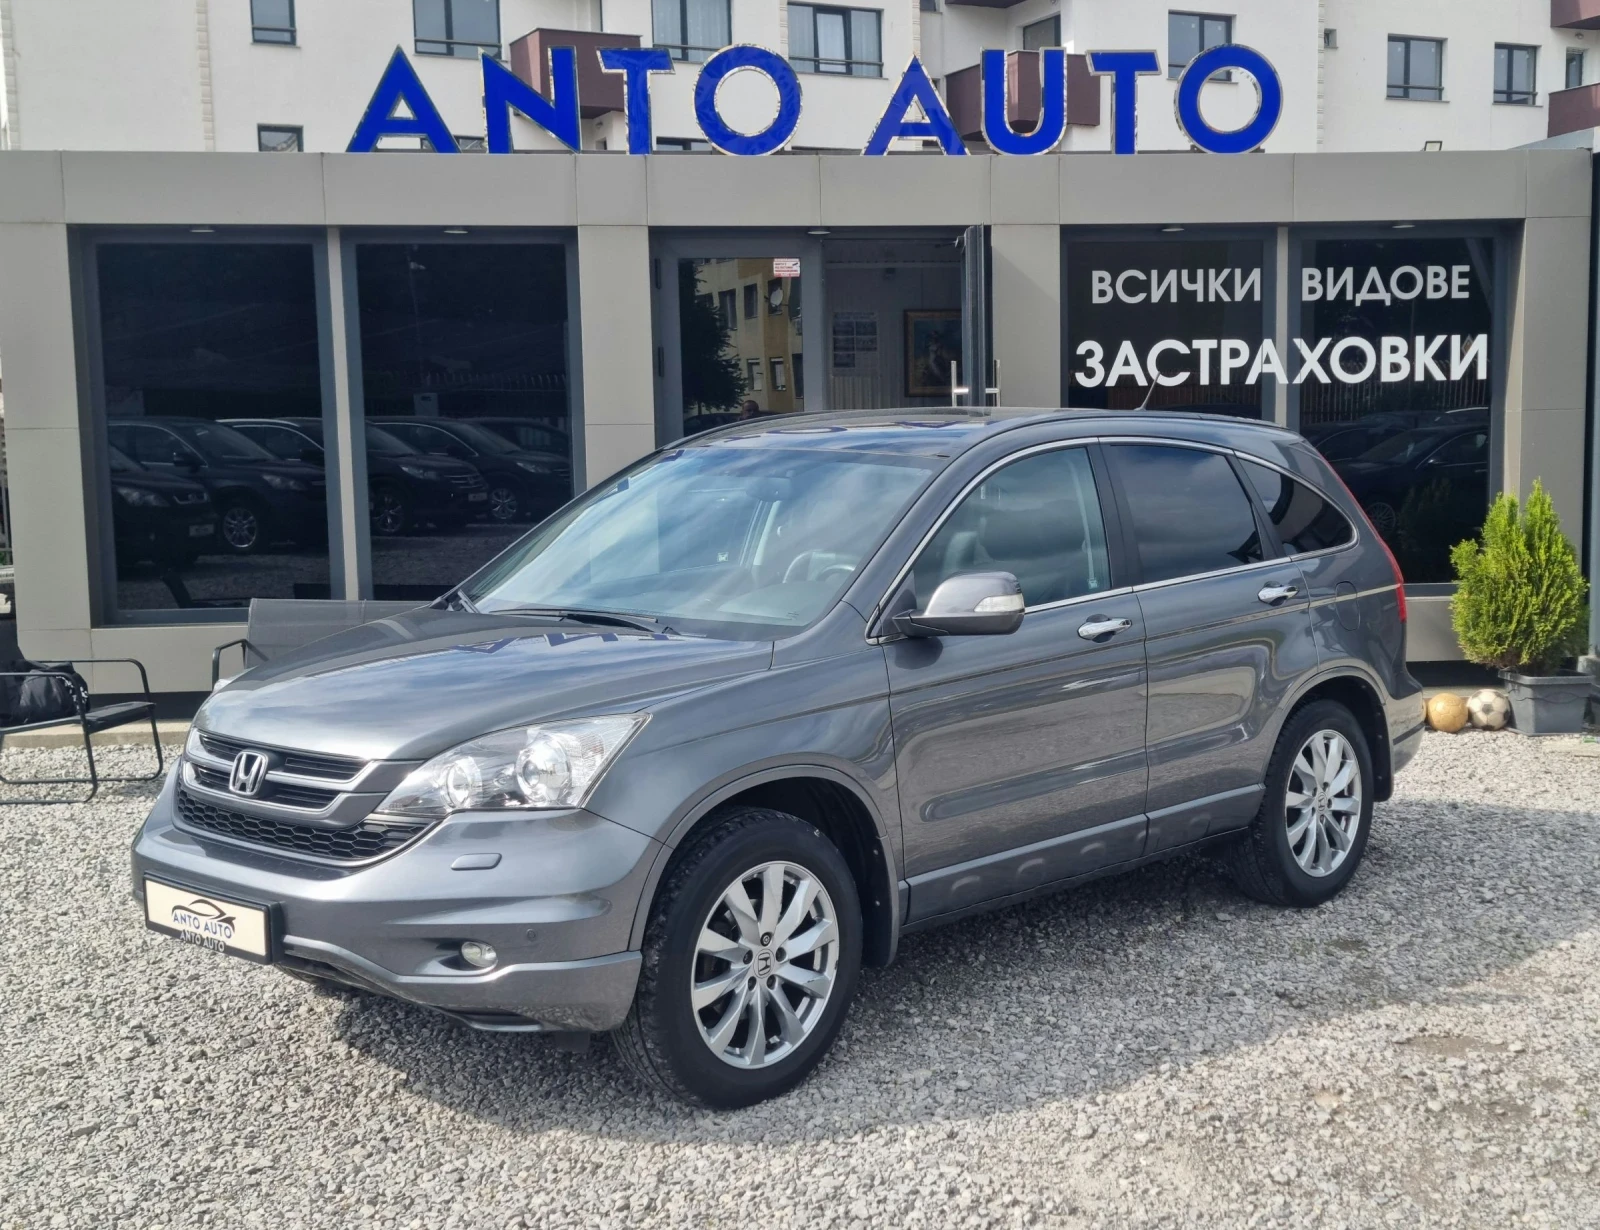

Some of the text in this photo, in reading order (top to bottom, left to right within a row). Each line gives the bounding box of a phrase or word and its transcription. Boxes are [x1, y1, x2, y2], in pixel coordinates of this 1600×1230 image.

[346, 43, 1284, 156] ANTO AUTO
[1091, 264, 1471, 307] ВСИЧКИ ВИДОВЕ
[1074, 333, 1489, 388] ЗАСТРАХОВКИ
[173, 912, 232, 939] ANTO AUTO
[179, 929, 225, 952] ANTO AUTO
